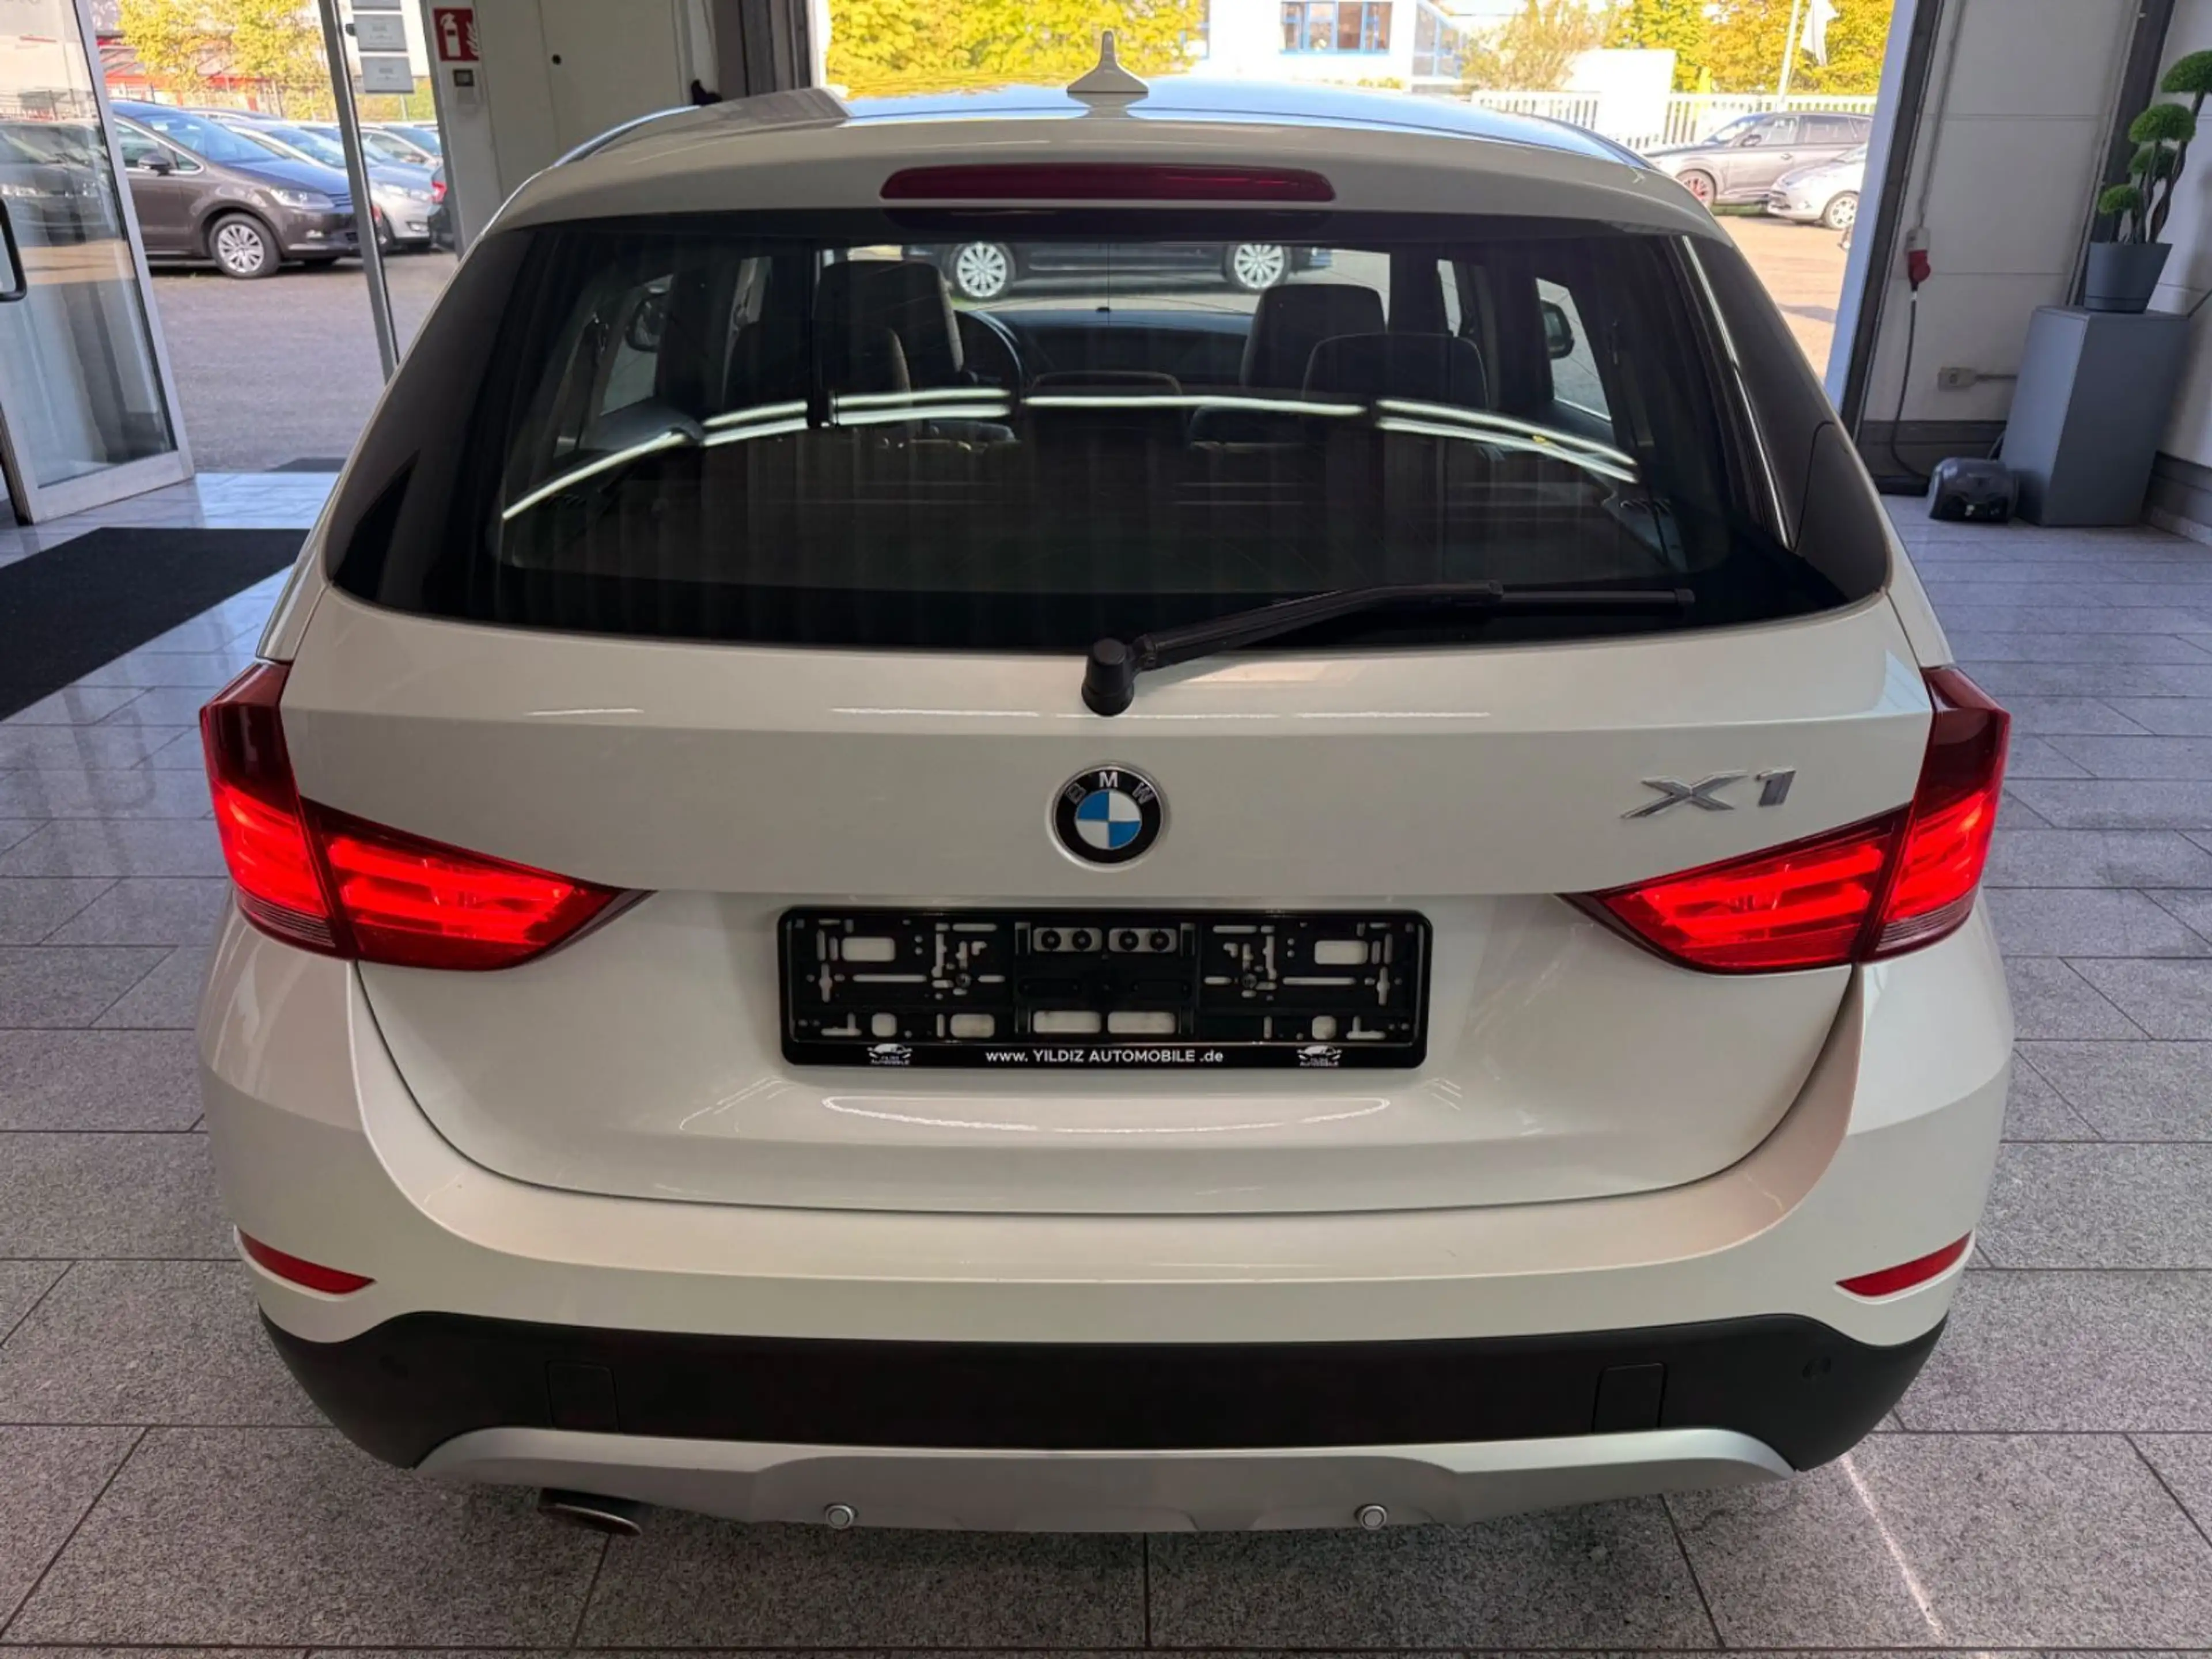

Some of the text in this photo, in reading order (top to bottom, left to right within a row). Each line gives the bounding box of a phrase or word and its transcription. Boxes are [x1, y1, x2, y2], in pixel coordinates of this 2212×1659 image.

[1066, 771, 1155, 805] BMW
[1620, 767, 1796, 819] X1
[986, 1049, 1224, 1062] www. YILDIZ AUTOMOBILE .de
